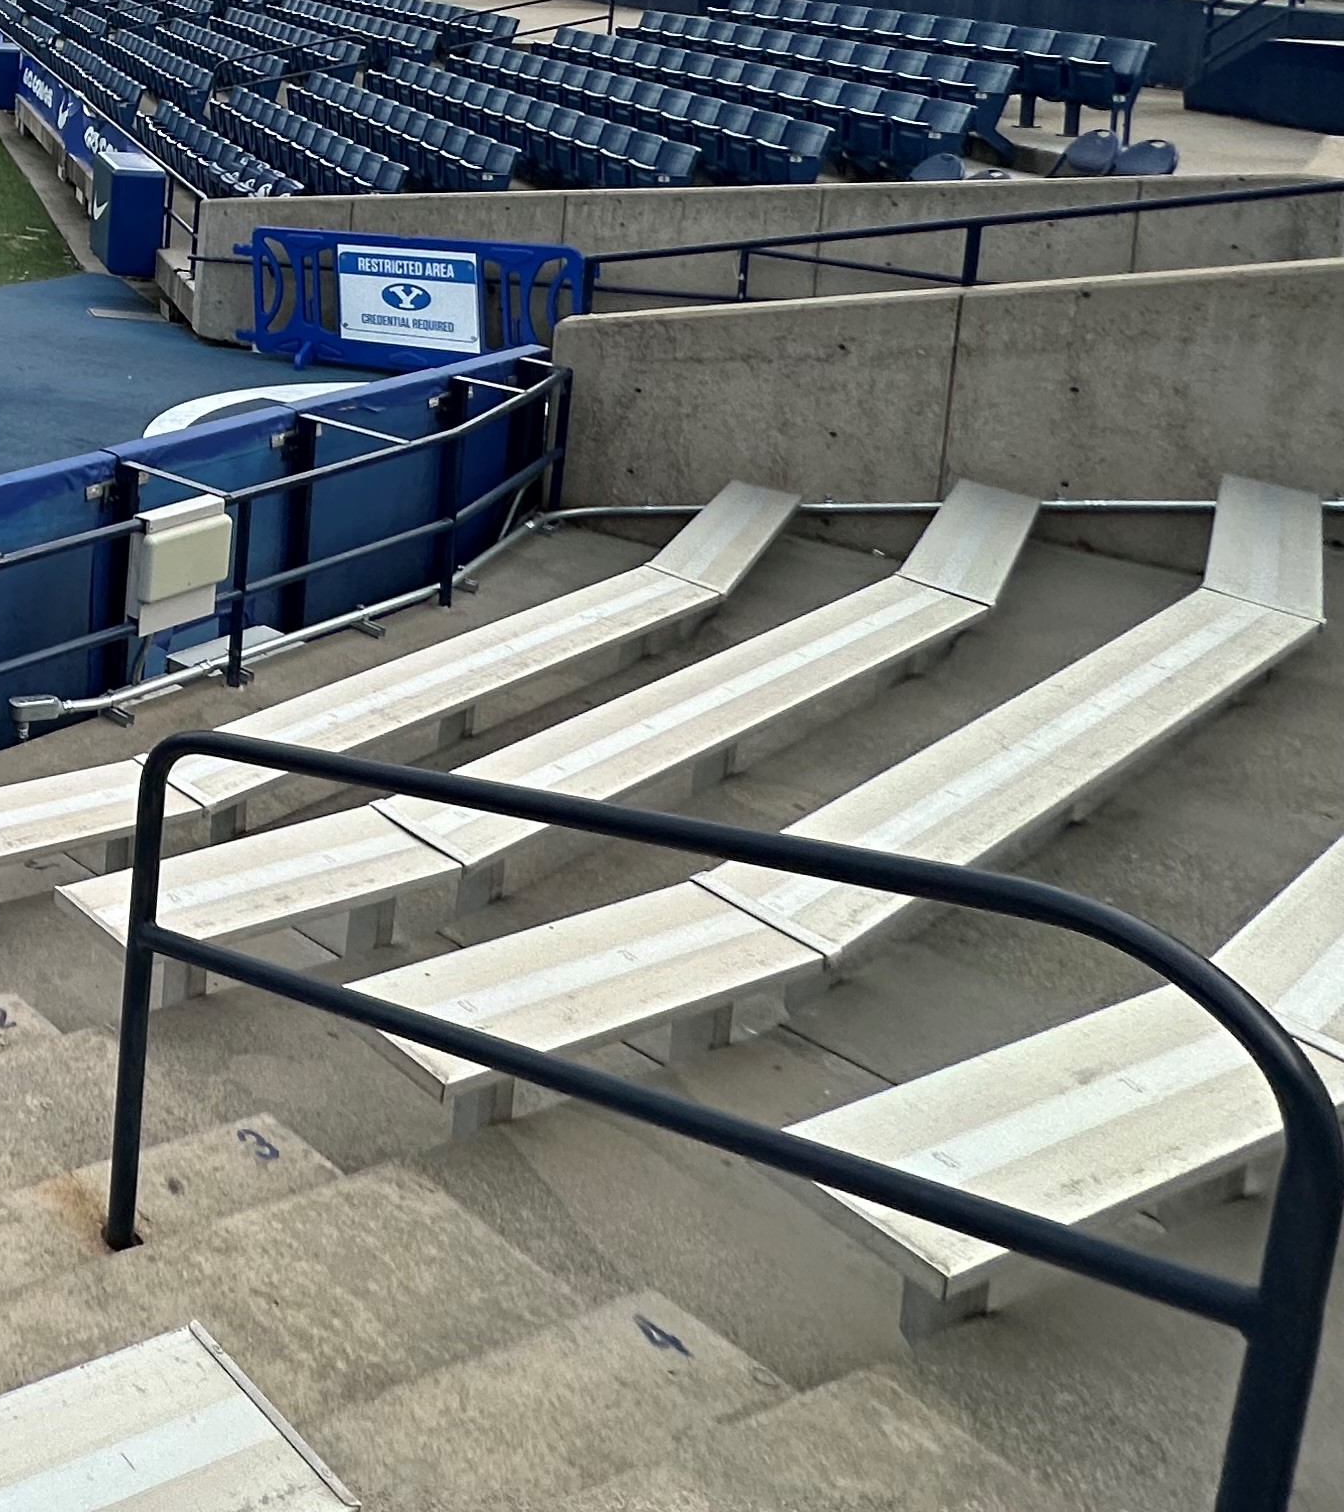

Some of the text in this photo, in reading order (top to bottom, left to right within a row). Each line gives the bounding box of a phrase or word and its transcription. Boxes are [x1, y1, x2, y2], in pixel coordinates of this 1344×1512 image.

[357, 257, 455, 278] RESTRICTED AREA
[389, 285, 423, 309] Y
[361, 313, 455, 333] CREDENTIAL REQUIRED
[237, 1129, 279, 1160] 3
[632, 1313, 694, 1359] 4
